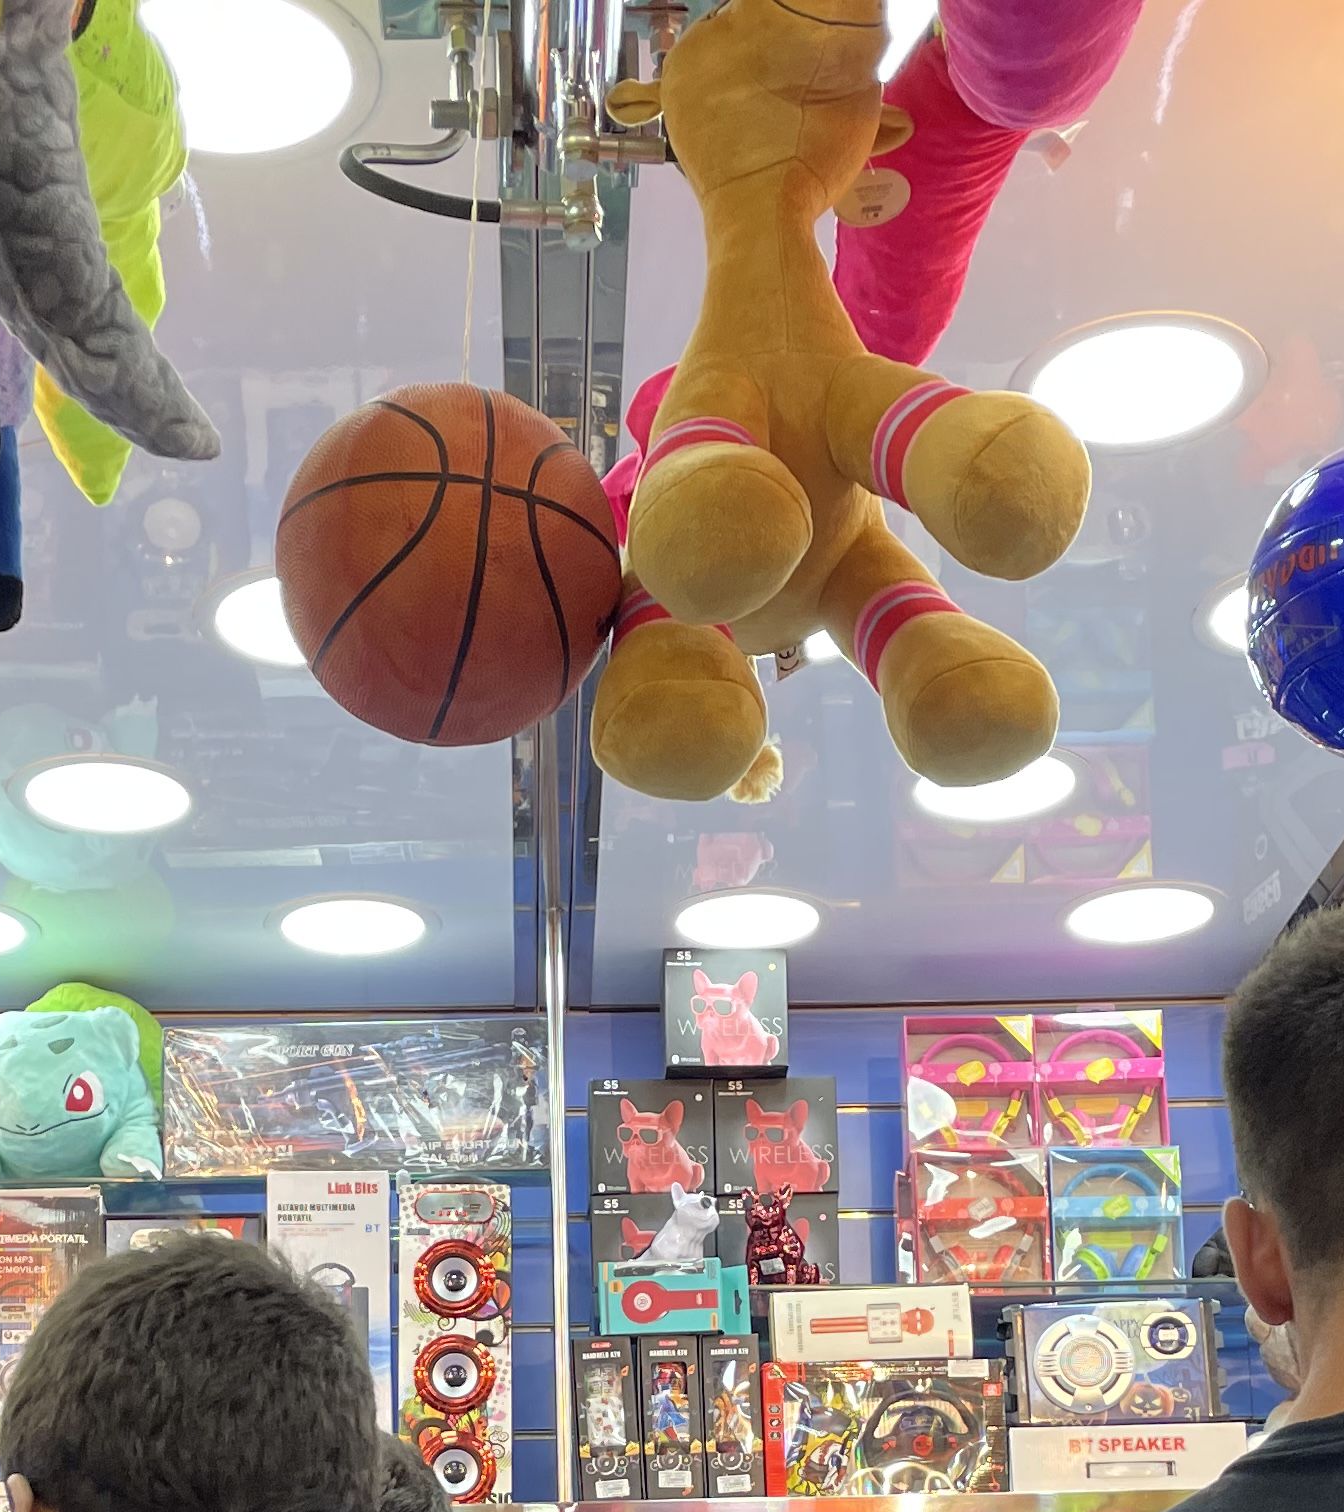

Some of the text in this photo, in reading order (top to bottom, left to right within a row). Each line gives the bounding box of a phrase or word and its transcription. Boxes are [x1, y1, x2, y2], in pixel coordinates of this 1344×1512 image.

[676, 951, 692, 961] S5
[677, 1016, 783, 1036] WELESS
[603, 1080, 619, 1090] S5
[727, 1080, 743, 1091] S5
[729, 1143, 835, 1164] WIRELESS
[327, 1182, 379, 1195] Link Bits
[310, 1203, 356, 1212] MULTIMEDIA
[603, 1199, 619, 1209] S5
[364, 1224, 381, 1233] BT
[40, 1233, 89, 1245] PORTATIL
[13, 1255, 34, 1264] MP3
[1098, 1436, 1186, 1453] SPEAKER
